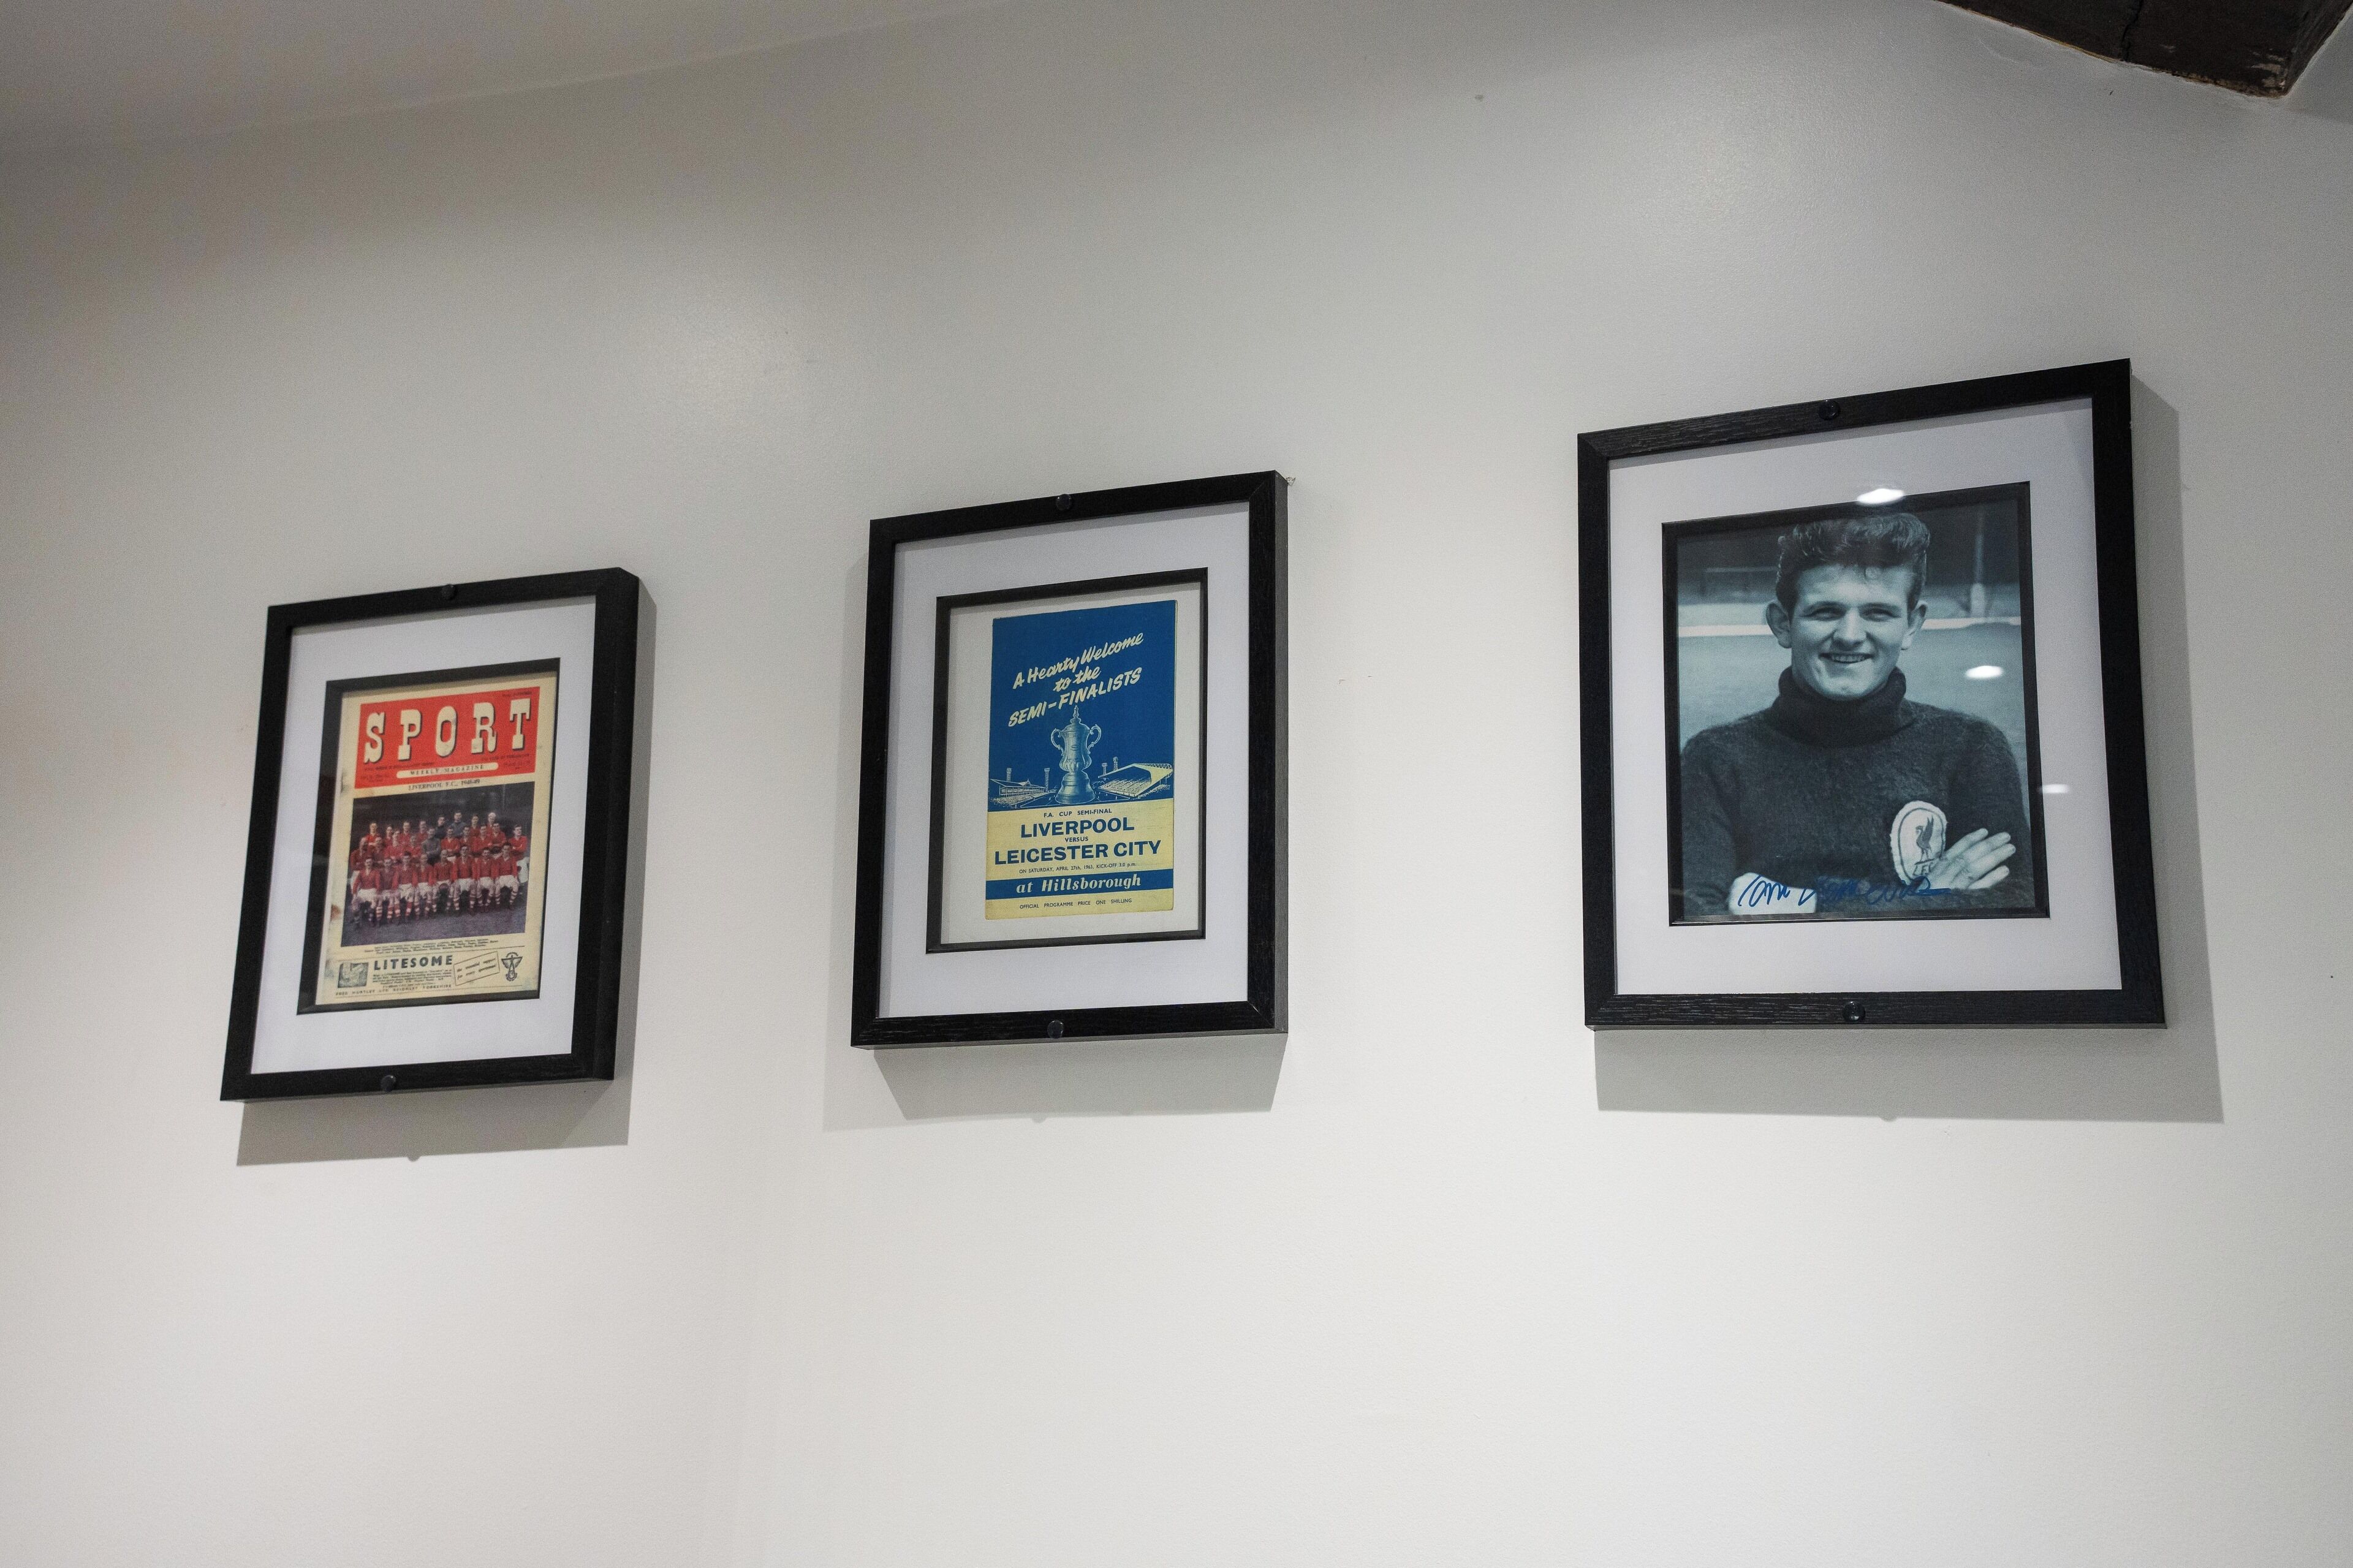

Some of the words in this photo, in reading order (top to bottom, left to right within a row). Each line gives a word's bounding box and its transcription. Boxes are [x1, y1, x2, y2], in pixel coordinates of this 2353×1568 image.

[1013, 672, 1025, 689] A
[1027, 656, 1080, 683] Hearty
[1080, 632, 1144, 664] Welcome
[1053, 678, 1072, 692] to
[1072, 665, 1101, 684] the
[1008, 667, 1142, 727] SEMI-FINALISTS
[363, 698, 531, 764] SPORT
[444, 764, 485, 773] MAGAZINE
[408, 782, 442, 790] LIVERPOOL
[1020, 817, 1135, 838] LIVERPOOL
[995, 844, 1108, 865] LEICESTER
[1113, 840, 1161, 857] CITY
[1016, 882, 1033, 893] at
[1042, 874, 1142, 893] Hillsborough
[374, 955, 453, 971] LITESOME
